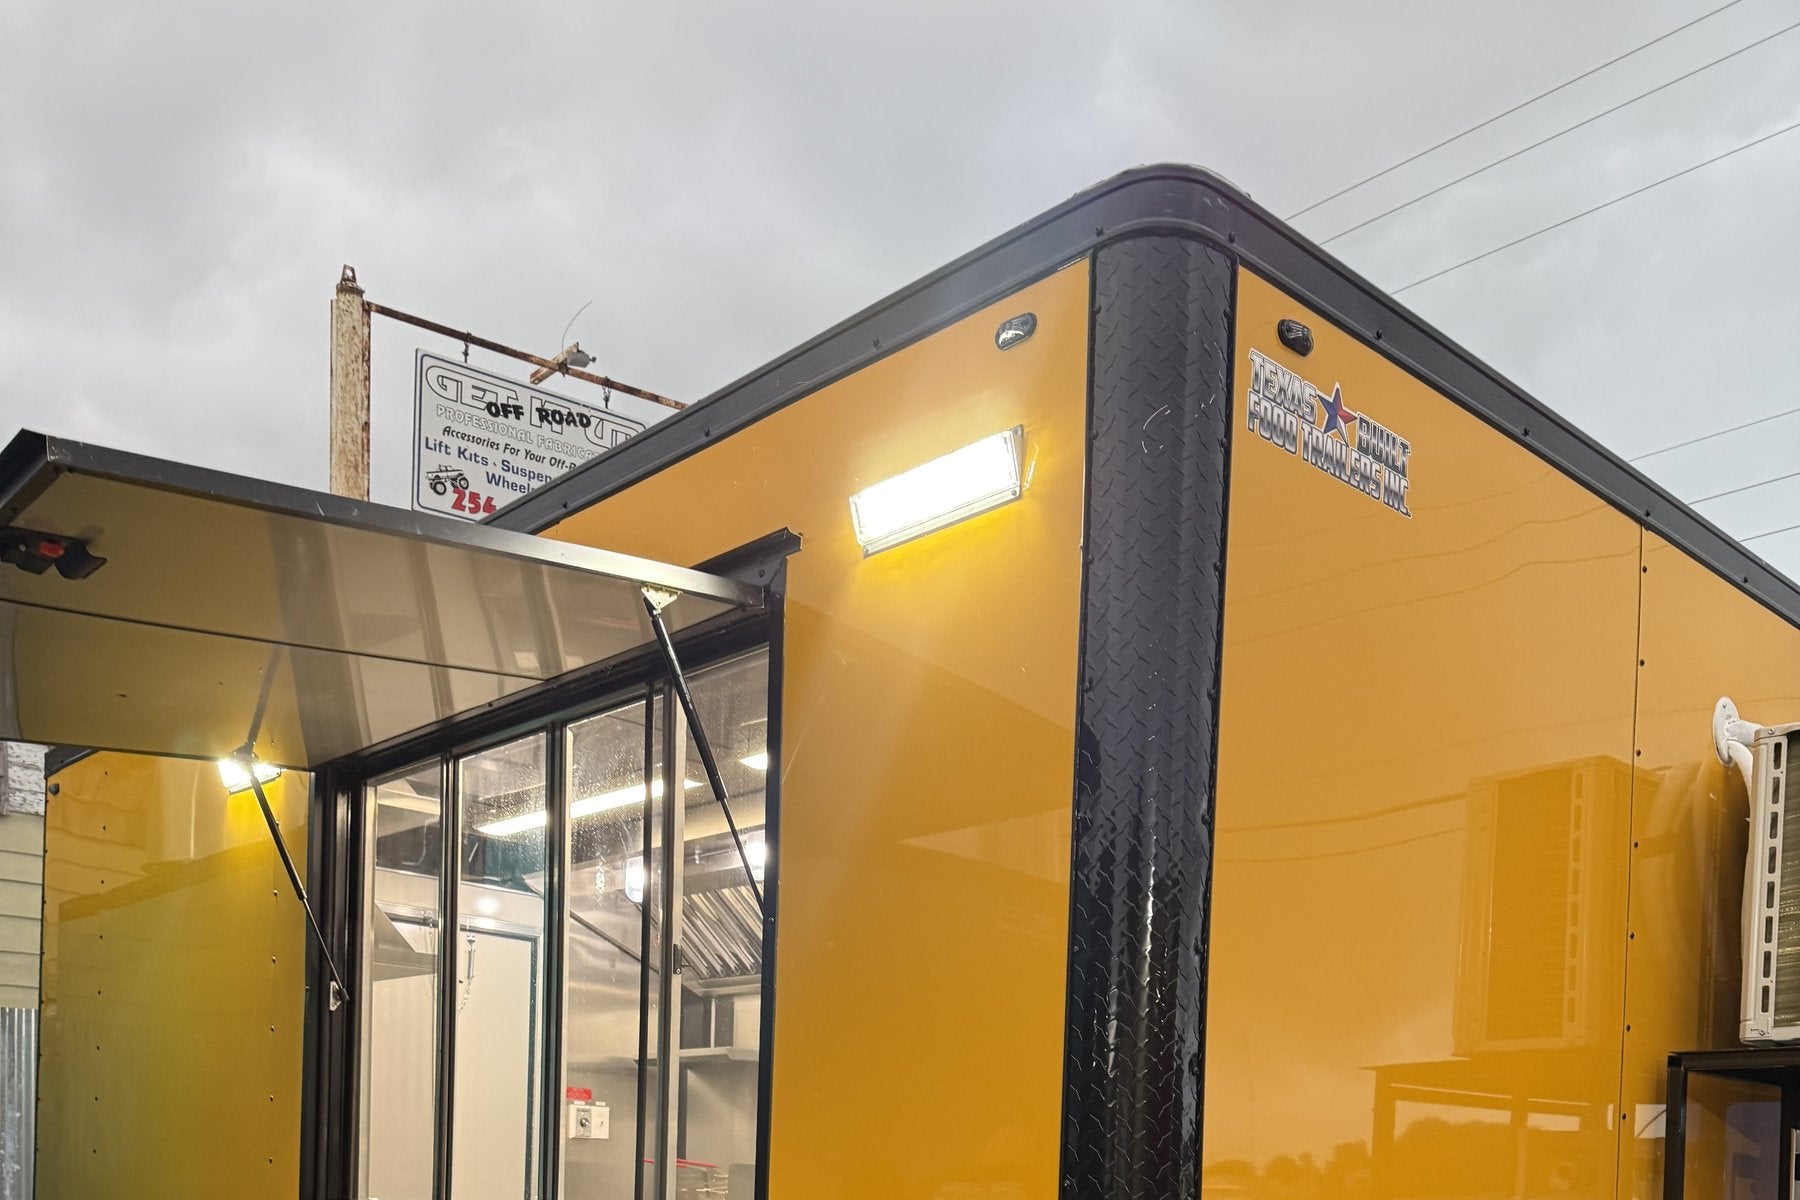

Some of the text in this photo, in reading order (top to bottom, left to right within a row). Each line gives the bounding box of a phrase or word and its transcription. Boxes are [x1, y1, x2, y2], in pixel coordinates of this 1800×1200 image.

[437, 404, 533, 444] PROFESSIONAL
[486, 401, 592, 429] OFF ROAD
[1249, 349, 1412, 479] TEXAS BUILT
[425, 437, 451, 456] Lift
[457, 446, 489, 466] Kits
[442, 426, 500, 450] Accessories
[503, 443, 520, 456] For
[524, 448, 546, 464] Your
[1248, 390, 1299, 455] FOOD
[1301, 421, 1382, 501] TRAILERS
